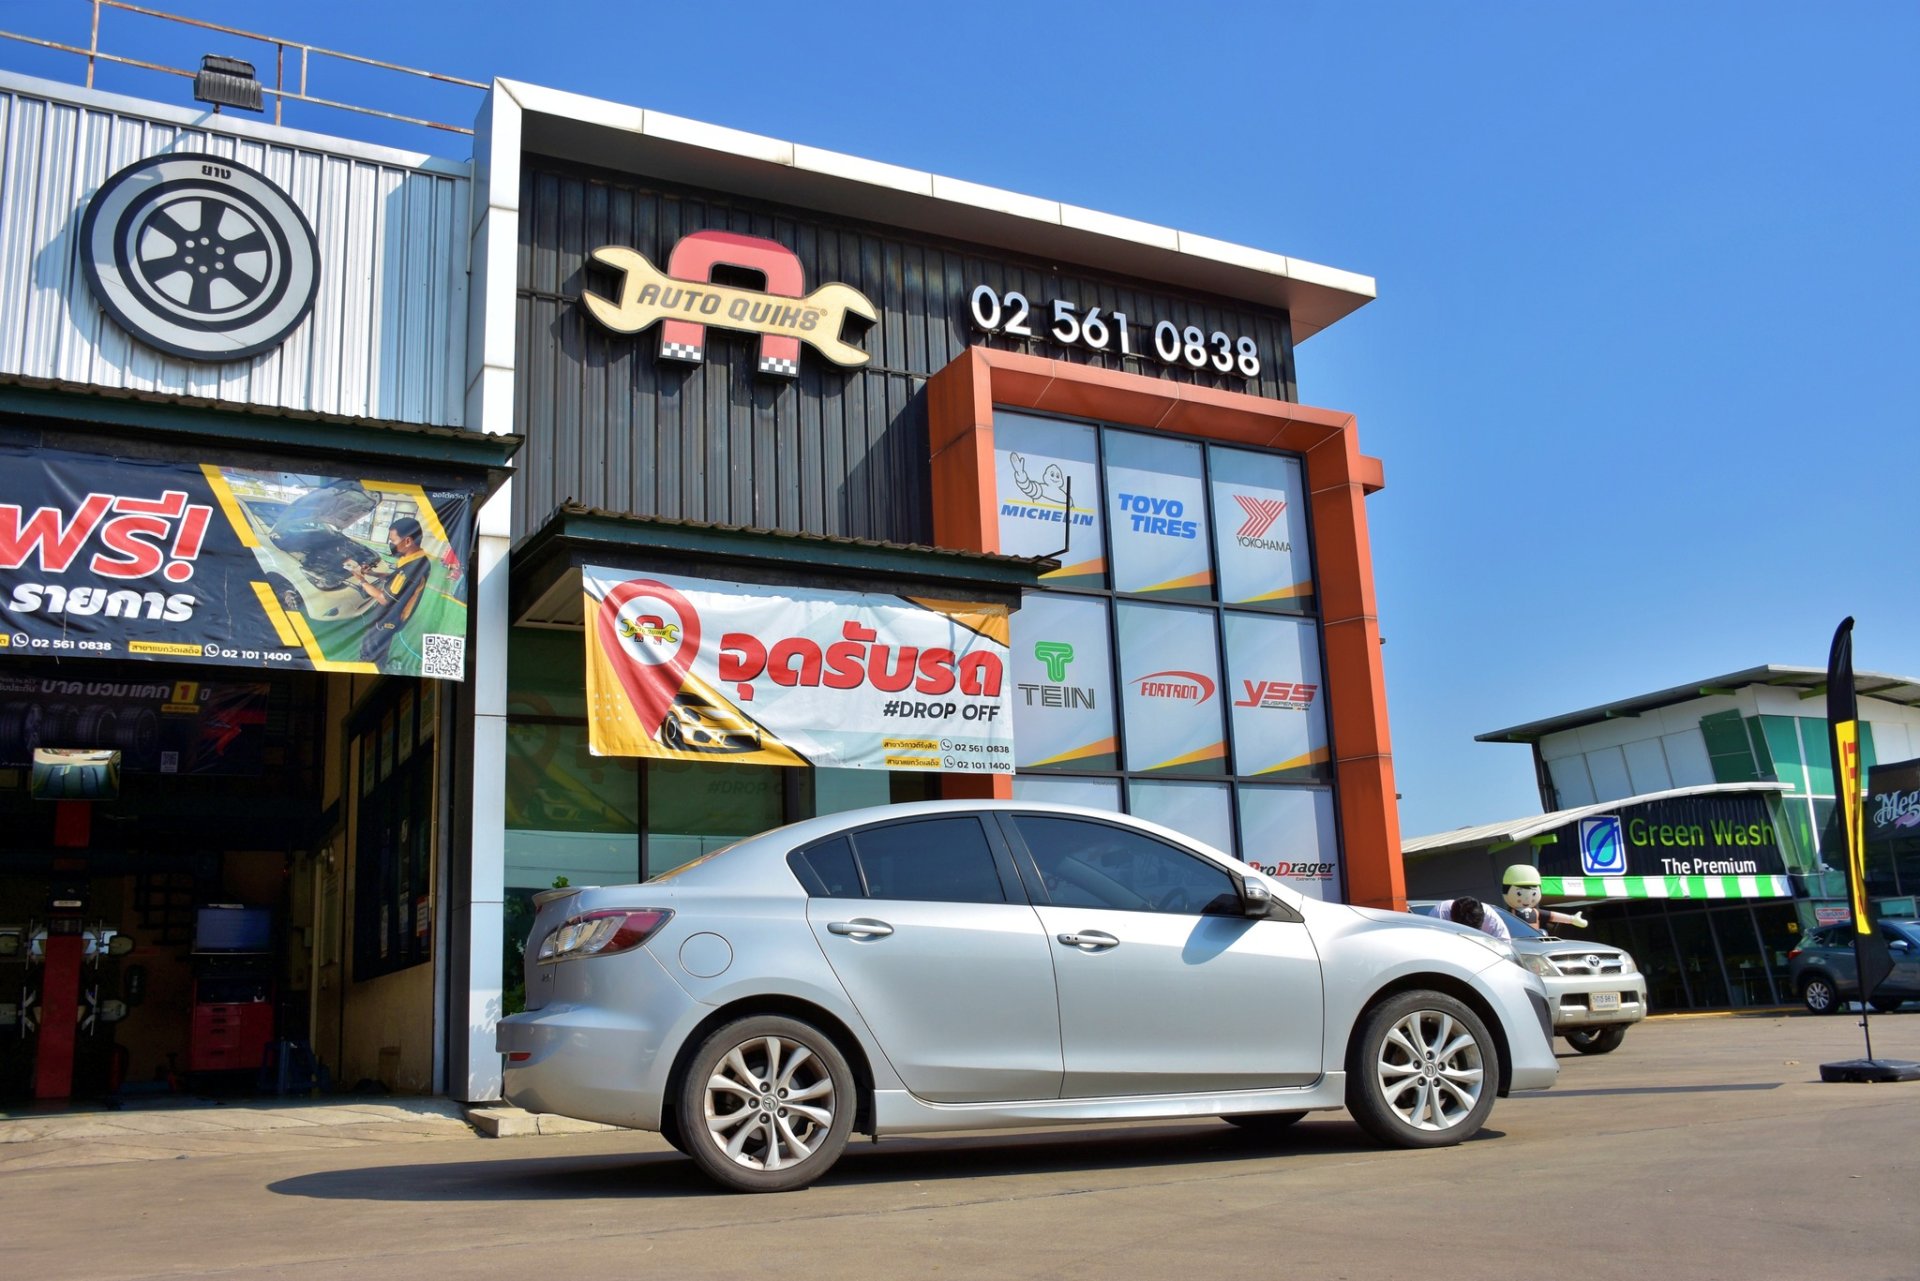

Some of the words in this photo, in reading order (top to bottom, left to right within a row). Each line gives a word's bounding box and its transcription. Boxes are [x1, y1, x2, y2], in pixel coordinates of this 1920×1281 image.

[202, 165, 232, 180] ยาง
[637, 284, 722, 315] AUTO
[728, 299, 820, 331] QUIKS
[971, 284, 1032, 336] 02
[1052, 299, 1130, 354] 561
[1155, 320, 1261, 377] 0838
[1118, 493, 1184, 518] TOYO
[0, 489, 214, 583] ฟรี!
[1130, 514, 1197, 540] TIRES
[1236, 535, 1293, 552] YOKOHAMA
[9, 582, 196, 622] รายการ
[31, 638, 49, 648] 02
[53, 640, 75, 649] 561
[79, 641, 112, 651] 0838
[221, 649, 237, 658] 02
[242, 650, 260, 660] 101
[264, 652, 292, 662] 1400
[719, 621, 1004, 701] จุดรับรถ
[41, 679, 83, 695] บาด
[86, 682, 127, 697] บวม
[129, 684, 170, 699] แตก
[180, 684, 190, 700] 1
[1018, 683, 1096, 710] TEIN
[1141, 682, 1198, 700] FORTRON
[883, 700, 957, 719] #DROP
[962, 704, 1001, 722] OFF
[955, 743, 967, 752] 02
[969, 745, 983, 754] 561
[987, 745, 1010, 753] 0838
[957, 761, 968, 769] 02
[972, 762, 986, 770] 101
[989, 762, 1011, 770] 1400
[1629, 818, 1704, 847] Green
[1710, 818, 1775, 847] Wash
[1661, 858, 1691, 875] The
[1694, 857, 1757, 874] Premium
